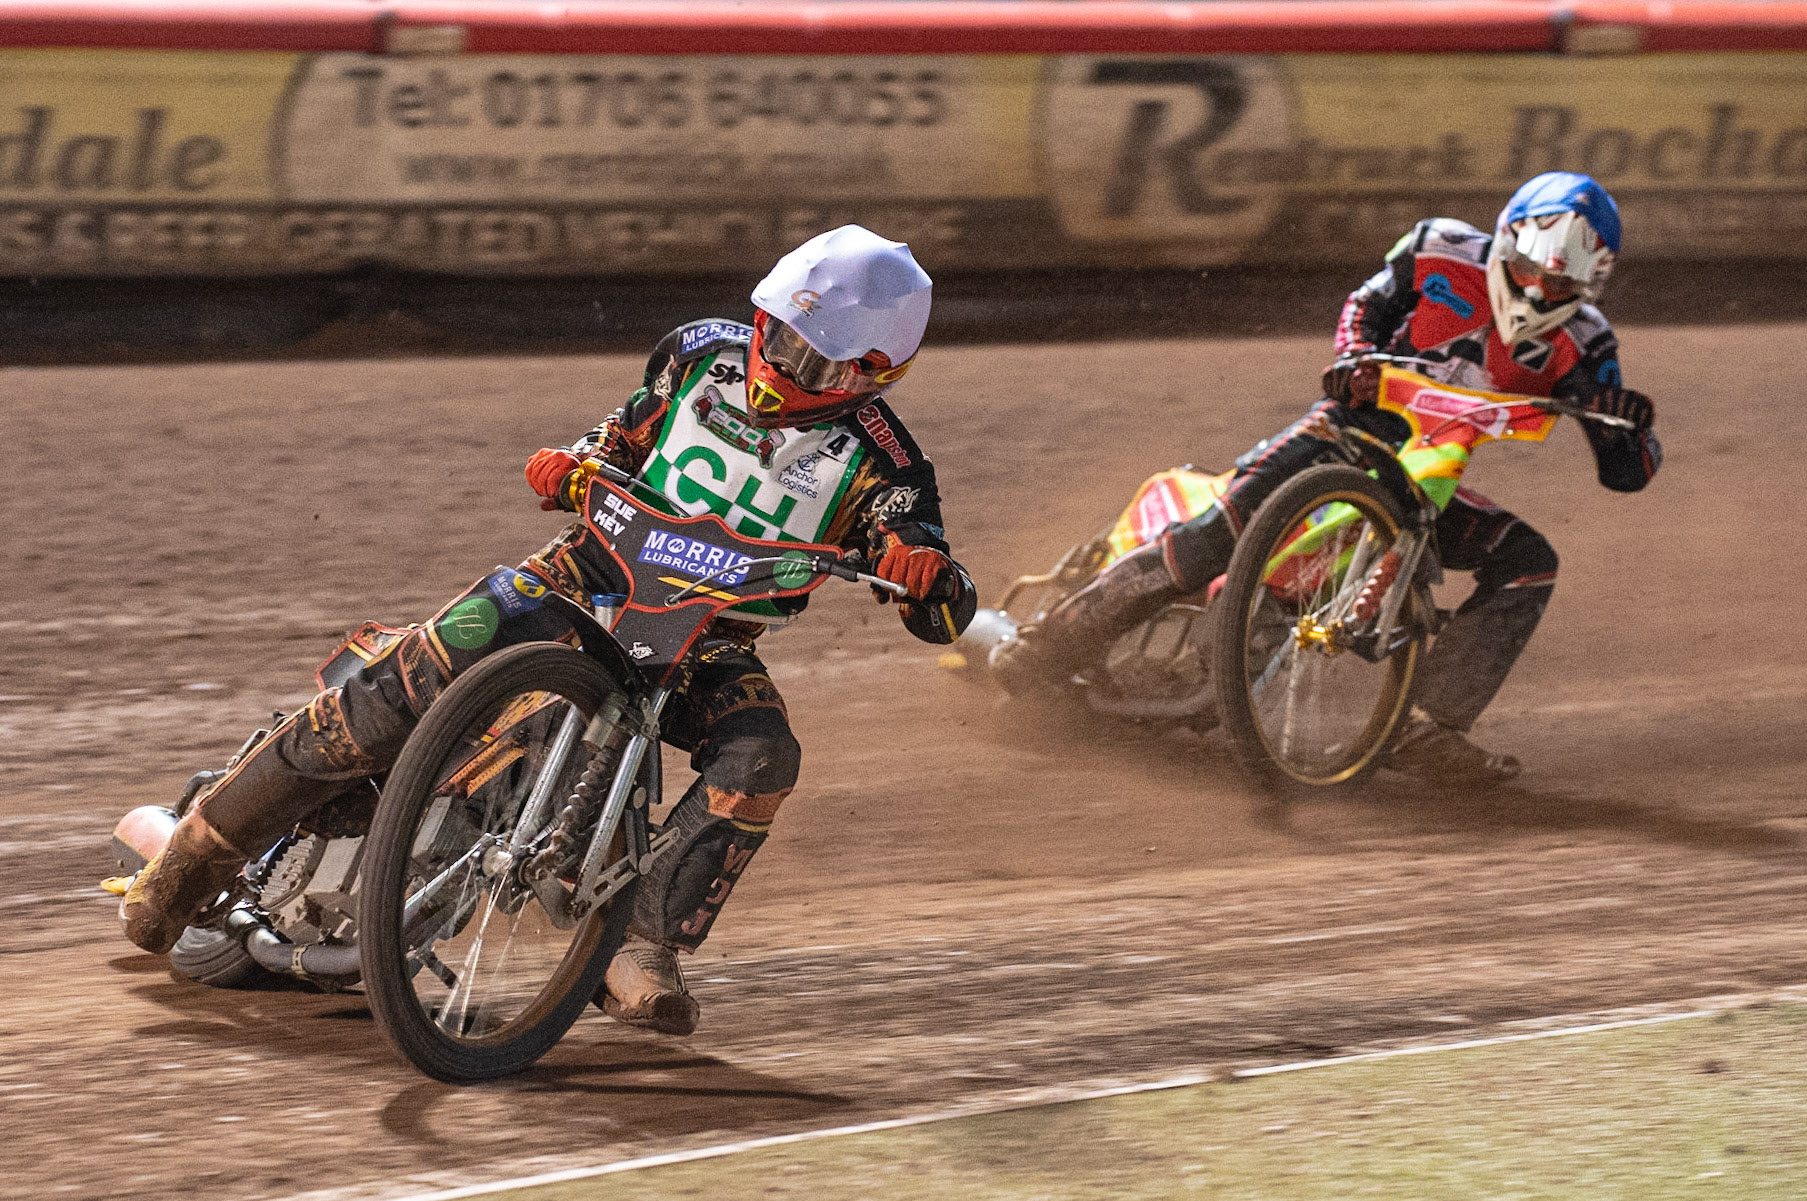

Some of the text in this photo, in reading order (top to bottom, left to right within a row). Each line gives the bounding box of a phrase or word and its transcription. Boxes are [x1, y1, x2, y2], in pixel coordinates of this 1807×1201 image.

[827, 433, 851, 456] 4
[778, 472, 819, 499] Logistics
[784, 465, 819, 485] Anchor
[603, 492, 637, 522] SUE
[593, 509, 626, 536] KEV
[644, 530, 754, 575] MORRIS
[644, 551, 738, 585] LUBRICANTS
[497, 576, 522, 609] MORRIS
